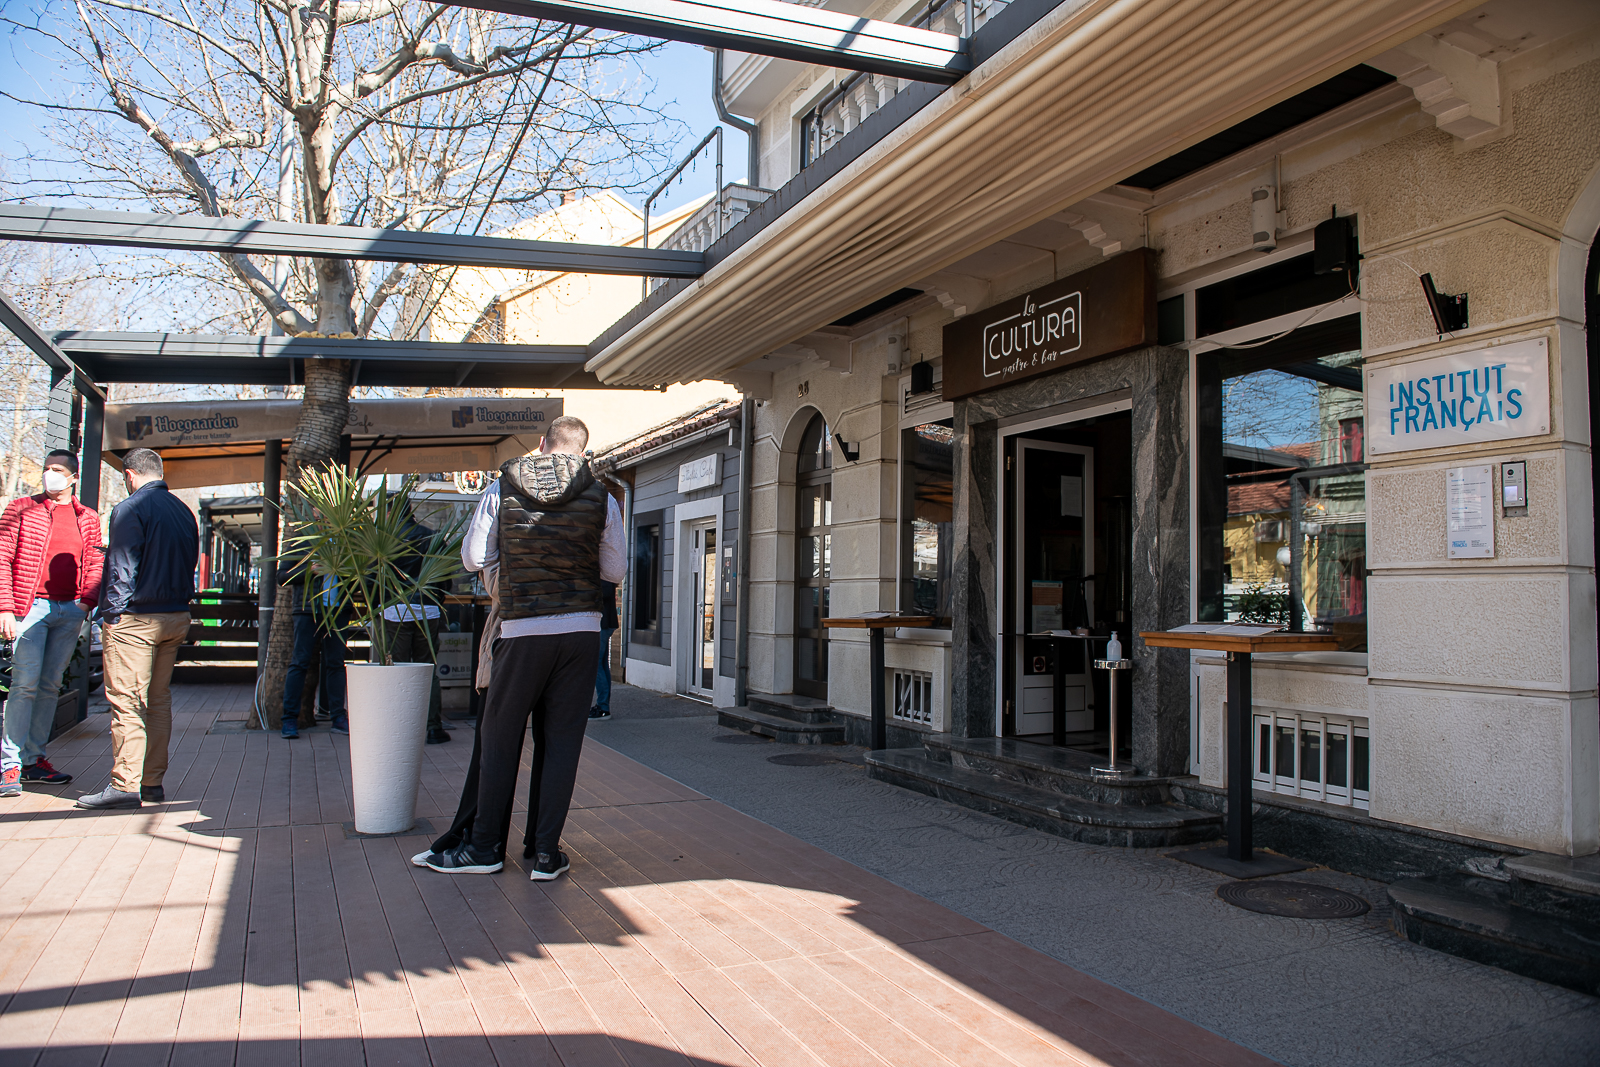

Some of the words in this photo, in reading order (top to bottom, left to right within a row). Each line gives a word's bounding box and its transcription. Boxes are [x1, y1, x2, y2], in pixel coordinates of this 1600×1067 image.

[1022, 294, 1037, 317] La
[989, 306, 1075, 360] CULTURA
[1031, 352, 1038, 367] &
[1041, 348, 1058, 365] bar
[1389, 363, 1507, 408] INSTITUT
[155, 412, 239, 434] Hoegaarden
[476, 406, 545, 424] Hoegaarden
[1390, 388, 1523, 436] FRANÇAIS
